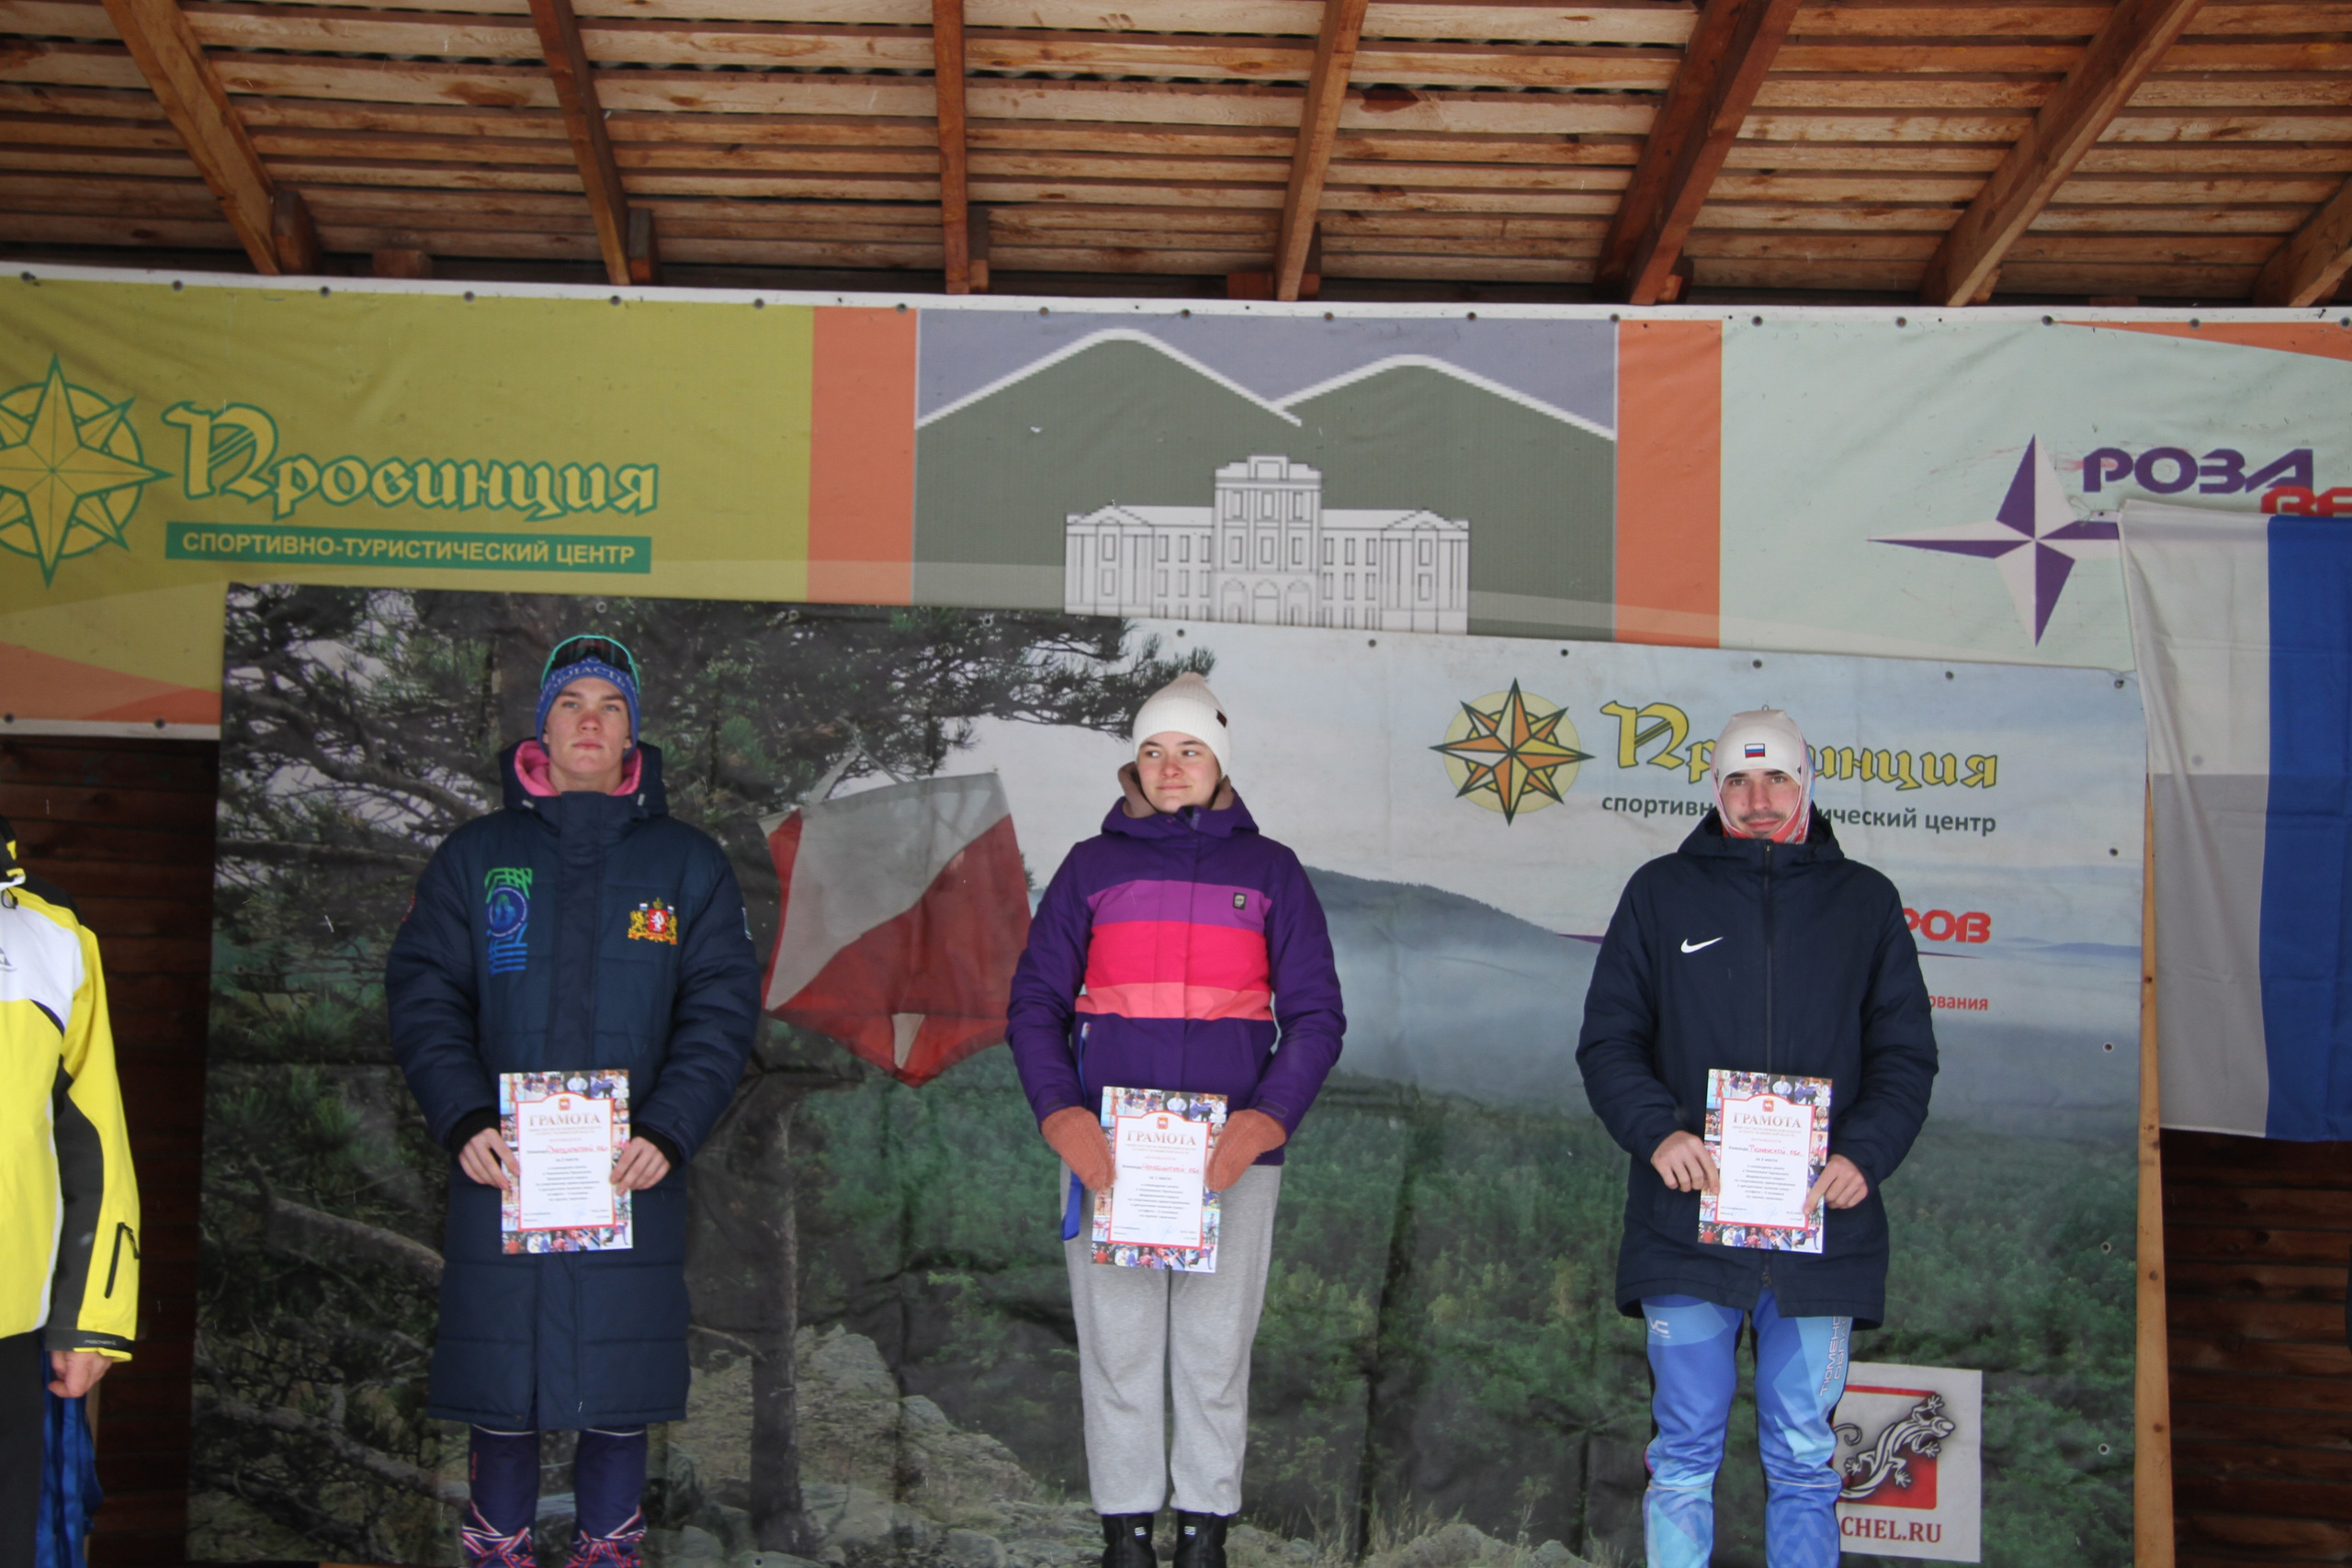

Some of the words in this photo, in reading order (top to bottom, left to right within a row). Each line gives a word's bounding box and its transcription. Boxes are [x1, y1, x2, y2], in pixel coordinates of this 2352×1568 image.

[160, 400, 659, 523] Провинция
[2083, 446, 2313, 493] РОЗА
[182, 532, 549, 562] СПОРТИВНО-ТУРИСТИЧЕСКИЙ
[556, 543, 636, 566] ЦЕНТР
[1600, 700, 1997, 791] Принция
[1925, 814, 1996, 837] центр
[528, 1112, 601, 1127] ГРАМОТА
[1734, 1112, 1801, 1128] ГРАМОТА
[1126, 1130, 1196, 1145] ГРАМОТА
[1819, 1316, 1840, 1397] ТЮМЕНС
[1840, 1517, 1941, 1544] CHEL.RU
